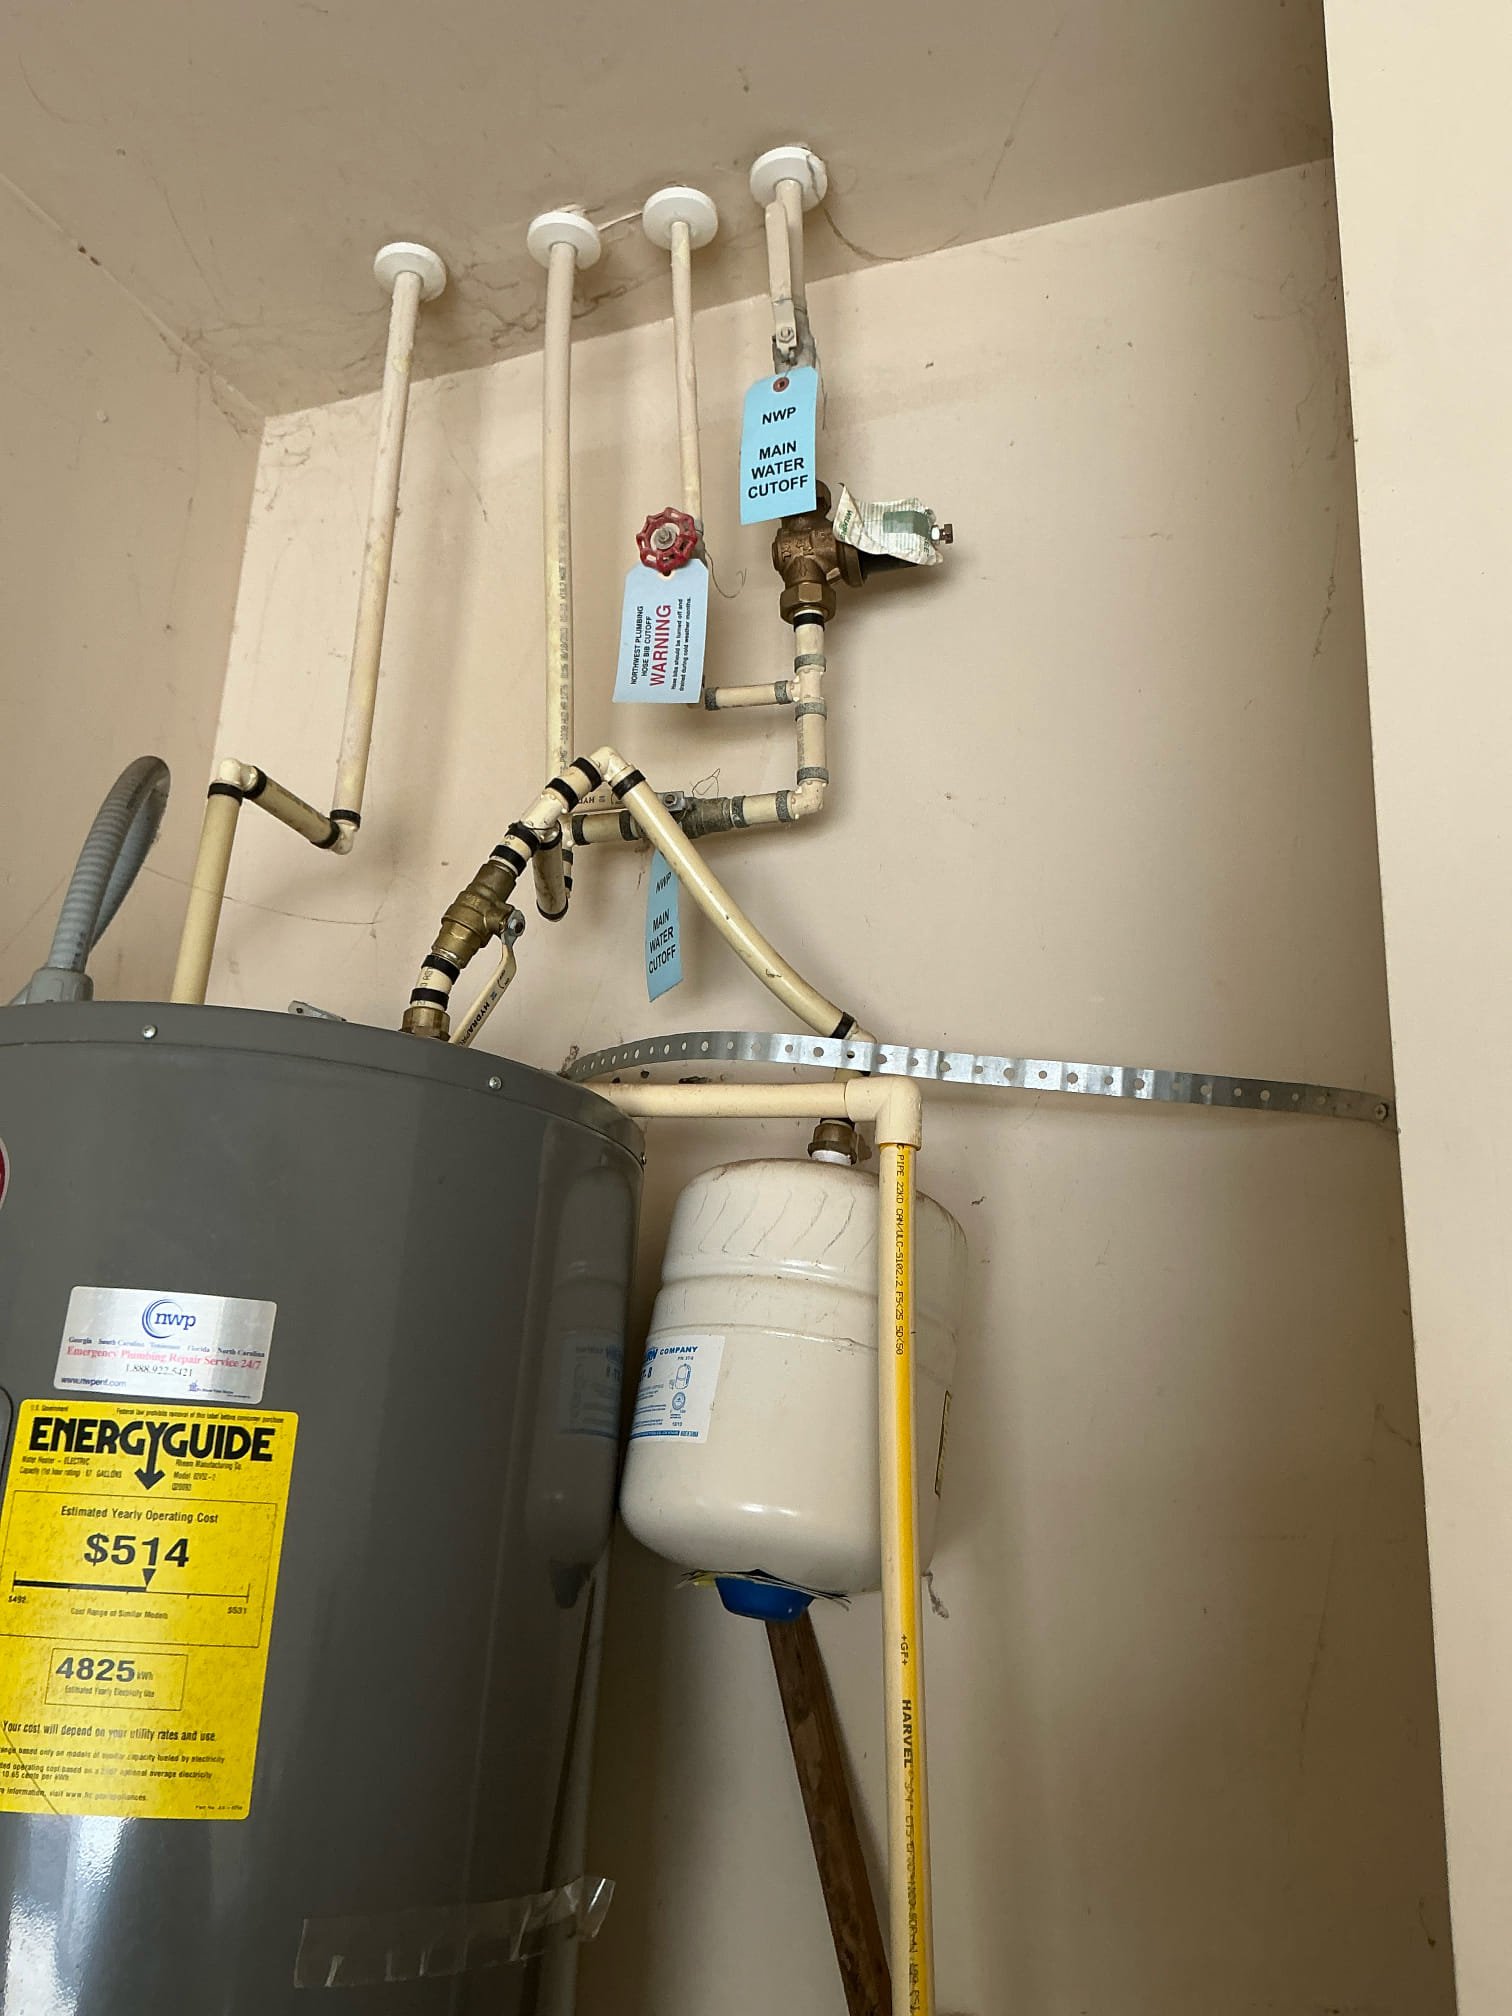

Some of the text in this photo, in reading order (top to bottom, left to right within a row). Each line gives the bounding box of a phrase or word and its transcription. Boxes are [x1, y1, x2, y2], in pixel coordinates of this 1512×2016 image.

[762, 406, 796, 425] NWP
[759, 440, 797, 461] MAIN
[751, 457, 805, 480] WATER
[748, 474, 809, 500] CUTOFF
[630, 605, 644, 685] NORTHWEST PLUMBING
[641, 615, 653, 677] HOSE BIB CUTOFF
[649, 604, 672, 687] WARNING
[676, 639, 681, 647] be
[655, 871, 672, 894] NWP
[652, 908, 670, 934] MAIN
[649, 926, 674, 954] WATER
[648, 943, 676, 975] CUTOFF
[896, 1154, 905, 1177] PIPE
[154, 1312, 197, 1331] nwp
[218, 1347, 236, 1356] North
[660, 1346, 698, 1355] COMPANY
[895, 1325, 904, 1356] SD<50
[67, 1346, 262, 1371] Emergency Plumbing Repair Service 24/7
[29, 1416, 276, 1462] ENERGYGUIDE
[61, 1505, 219, 1524] Estimated Yearly Operating Cost
[84, 1533, 190, 1568] $514
[87, 1608, 108, 1618] Range
[118, 1610, 142, 1618] Similar
[144, 1611, 169, 1620] Models
[55, 1656, 154, 1683] 4825 kWh
[65, 1685, 93, 1695] Estimated
[95, 1686, 112, 1697] Yearly
[114, 1688, 143, 1699] Electricity
[3, 1720, 22, 1732] Your
[23, 1723, 41, 1734] cost
[43, 1724, 59, 1735] will
[61, 1725, 93, 1738] depend
[95, 1728, 106, 1737] on
[108, 1729, 127, 1740] your
[130, 1728, 155, 1741] utility
[157, 1730, 179, 1741] rates
[181, 1730, 198, 1741] and
[902, 1699, 914, 1769] HARVEL
[40, 1749, 54, 1758] only
[157, 1754, 179, 1762] fueled
[181, 1756, 190, 1764] by
[13, 1763, 44, 1773] operating
[149, 1771, 177, 1779] average
